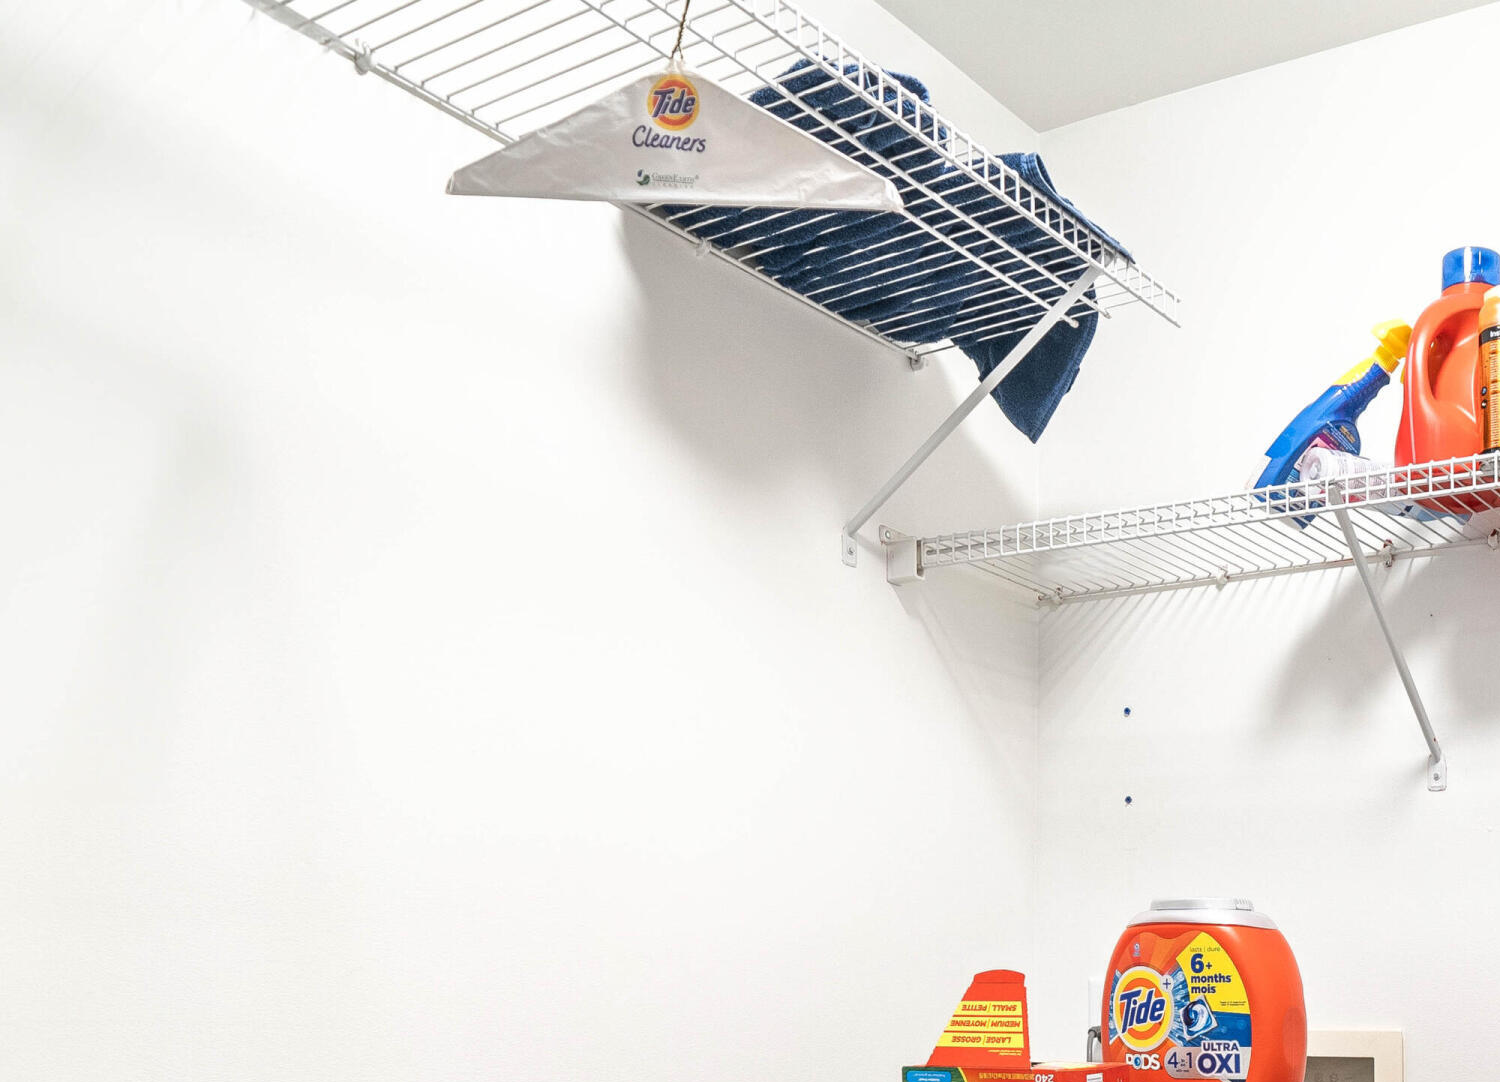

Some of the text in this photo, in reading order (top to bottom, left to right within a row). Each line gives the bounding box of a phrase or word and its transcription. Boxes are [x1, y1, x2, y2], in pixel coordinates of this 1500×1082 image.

[652, 88, 695, 117] Tide
[632, 125, 706, 152] Cleaners
[1191, 973, 1231, 983] months
[1191, 984, 1216, 994] mois
[1120, 989, 1165, 1034] Tide
[1203, 1042, 1239, 1051] ULTRA
[1126, 1053, 1159, 1070] PODS
[1198, 1053, 1240, 1074] OXI
[1035, 1074, 1054, 1082] 240
